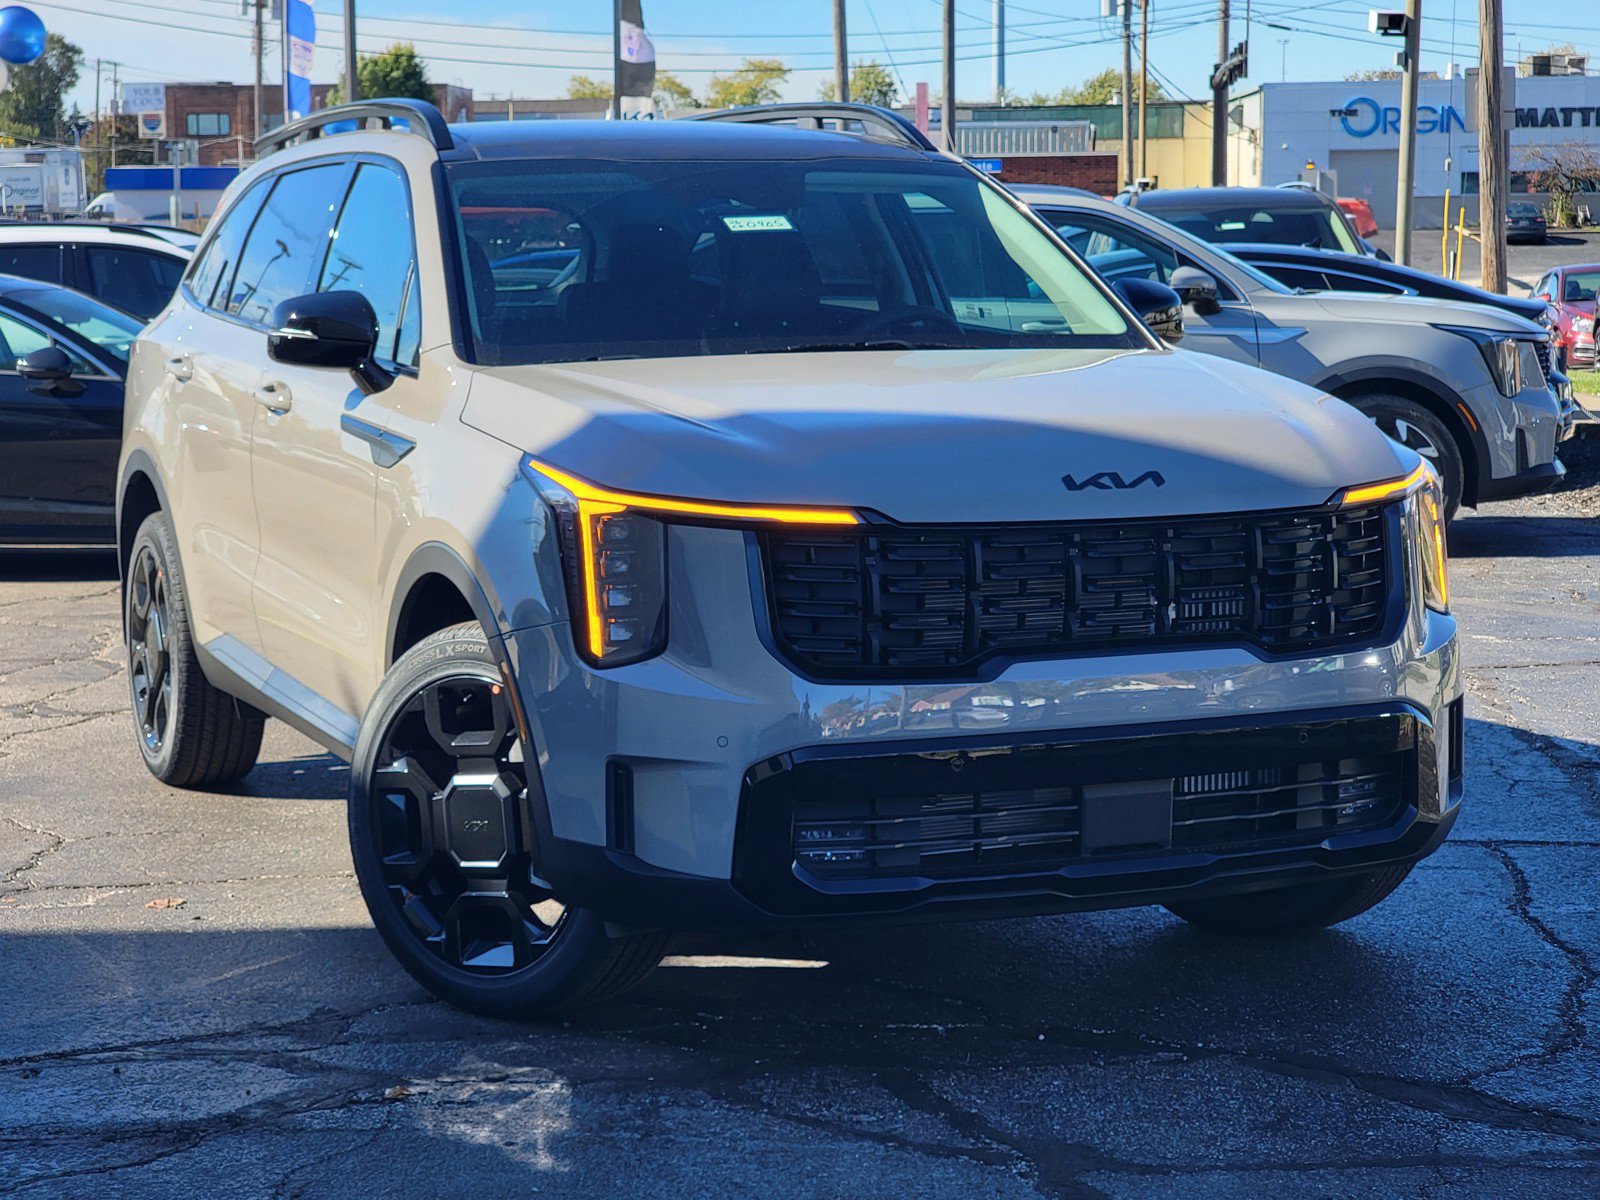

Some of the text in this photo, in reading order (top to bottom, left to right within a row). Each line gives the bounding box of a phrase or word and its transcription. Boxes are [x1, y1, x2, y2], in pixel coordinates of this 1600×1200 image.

[1329, 109, 1358, 117] THE
[1340, 97, 1466, 138] ORGIN
[1061, 470, 1165, 491] KIA
